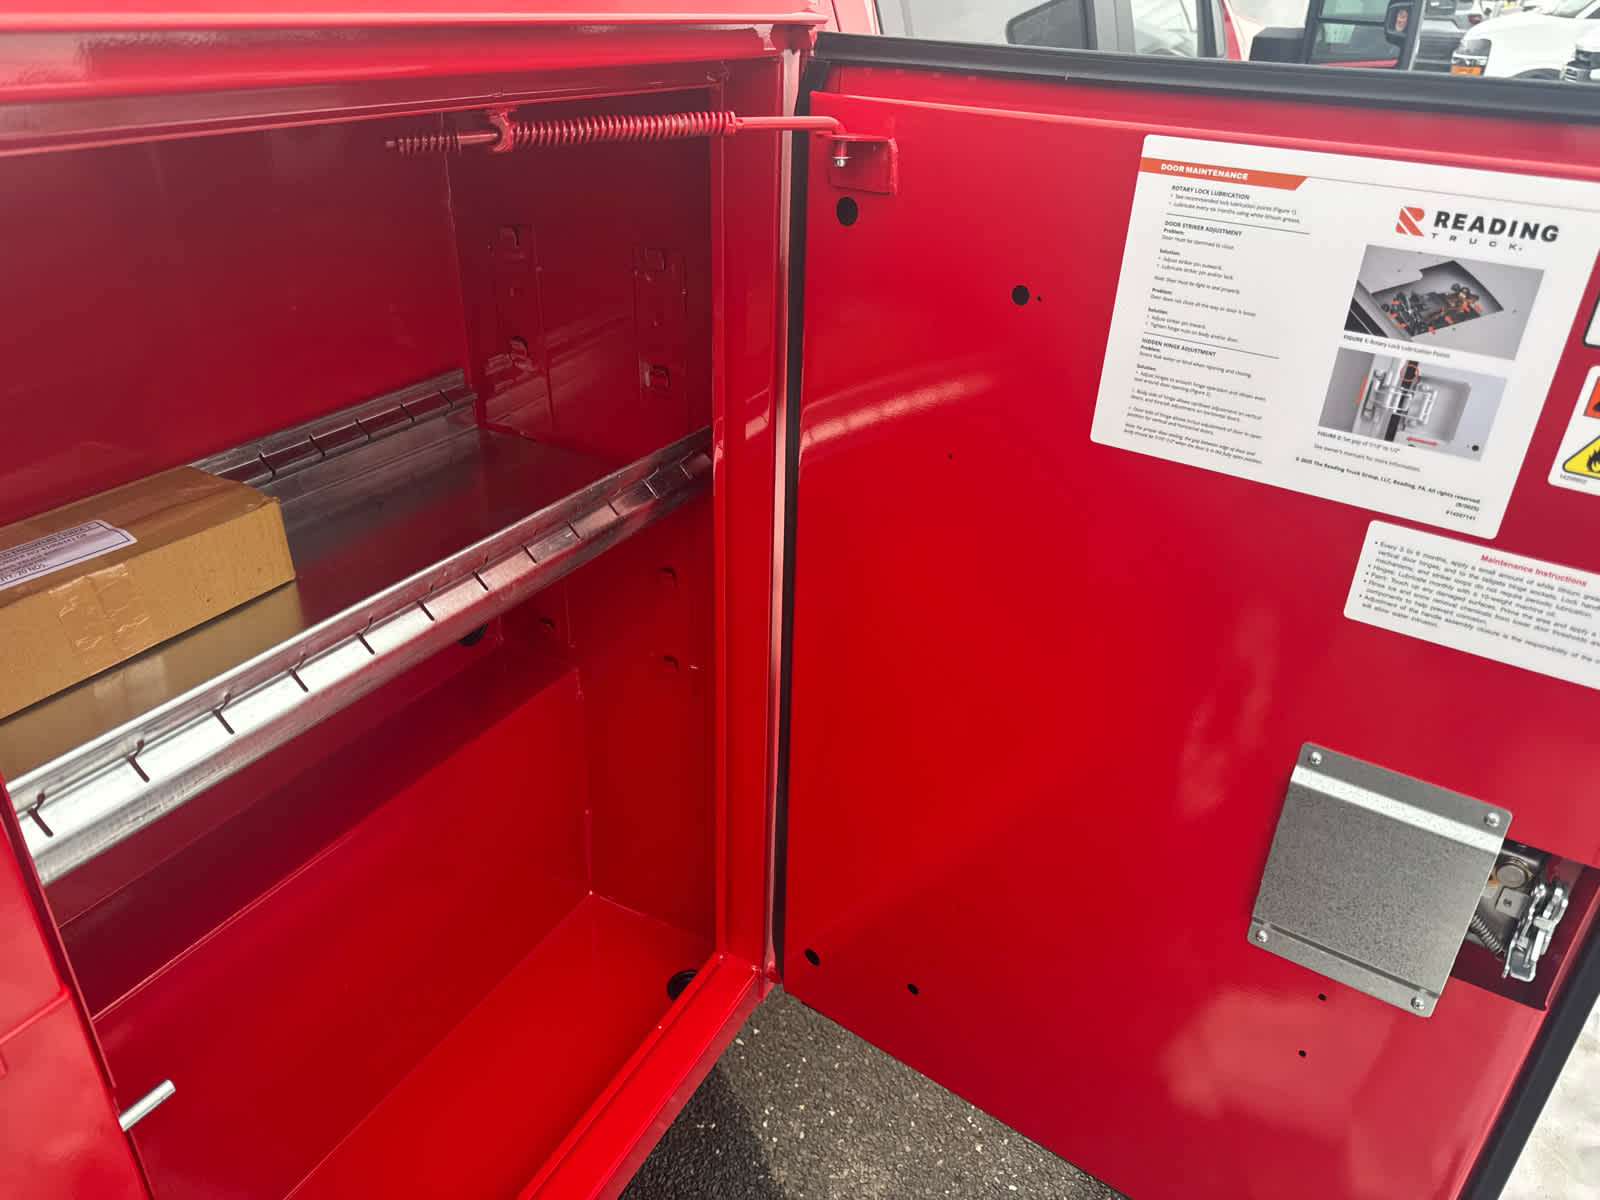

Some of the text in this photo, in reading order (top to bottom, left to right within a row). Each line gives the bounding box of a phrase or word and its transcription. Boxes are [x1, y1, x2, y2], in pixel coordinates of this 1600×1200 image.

[1186, 167, 1248, 178] MAINTENANCE
[1210, 190, 1250, 199] LUBRICATION
[1205, 226, 1242, 237] ADJUSTMENT
[1434, 211, 1558, 242] READING
[1181, 345, 1216, 357] ADJUSTMENT
[1481, 555, 1587, 585] Maintenance Instructions
